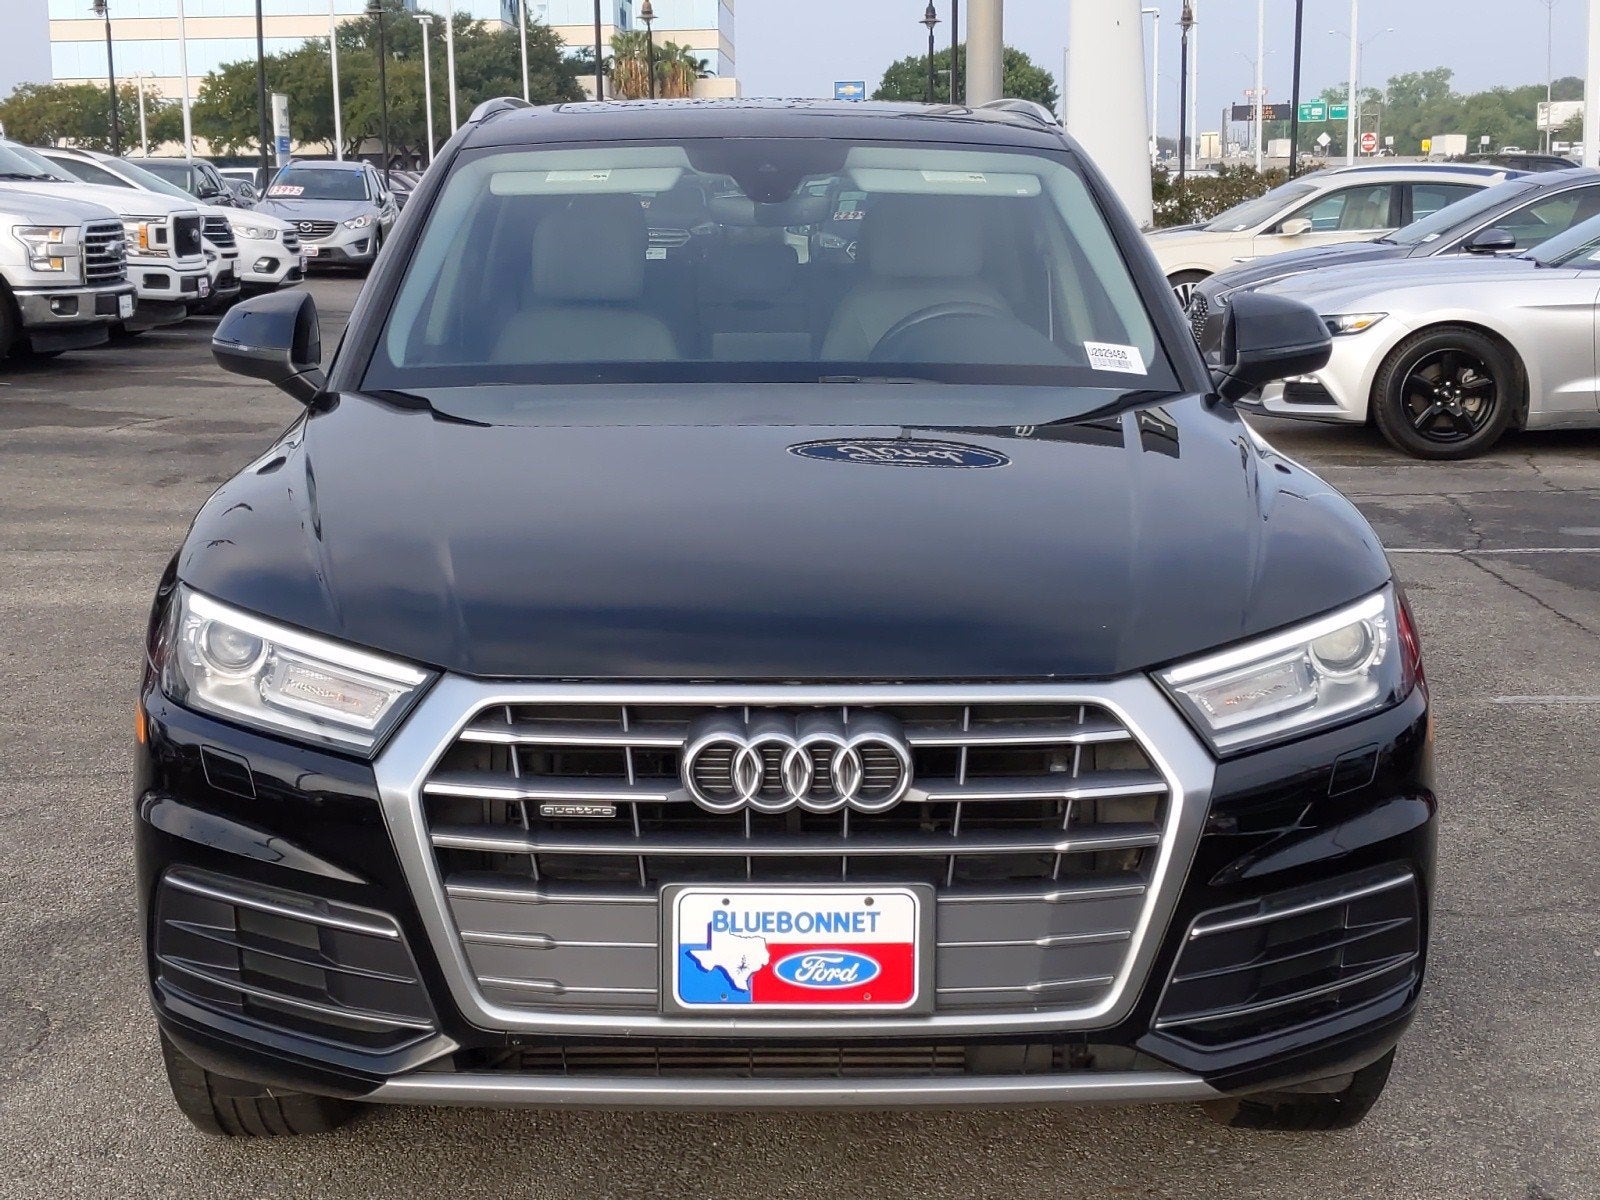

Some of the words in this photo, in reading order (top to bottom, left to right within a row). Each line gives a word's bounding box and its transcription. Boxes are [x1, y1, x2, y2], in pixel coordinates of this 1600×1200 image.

[543, 806, 613, 816] quattro
[712, 909, 881, 934] BLUEBONNET
[794, 955, 860, 982] Ford
